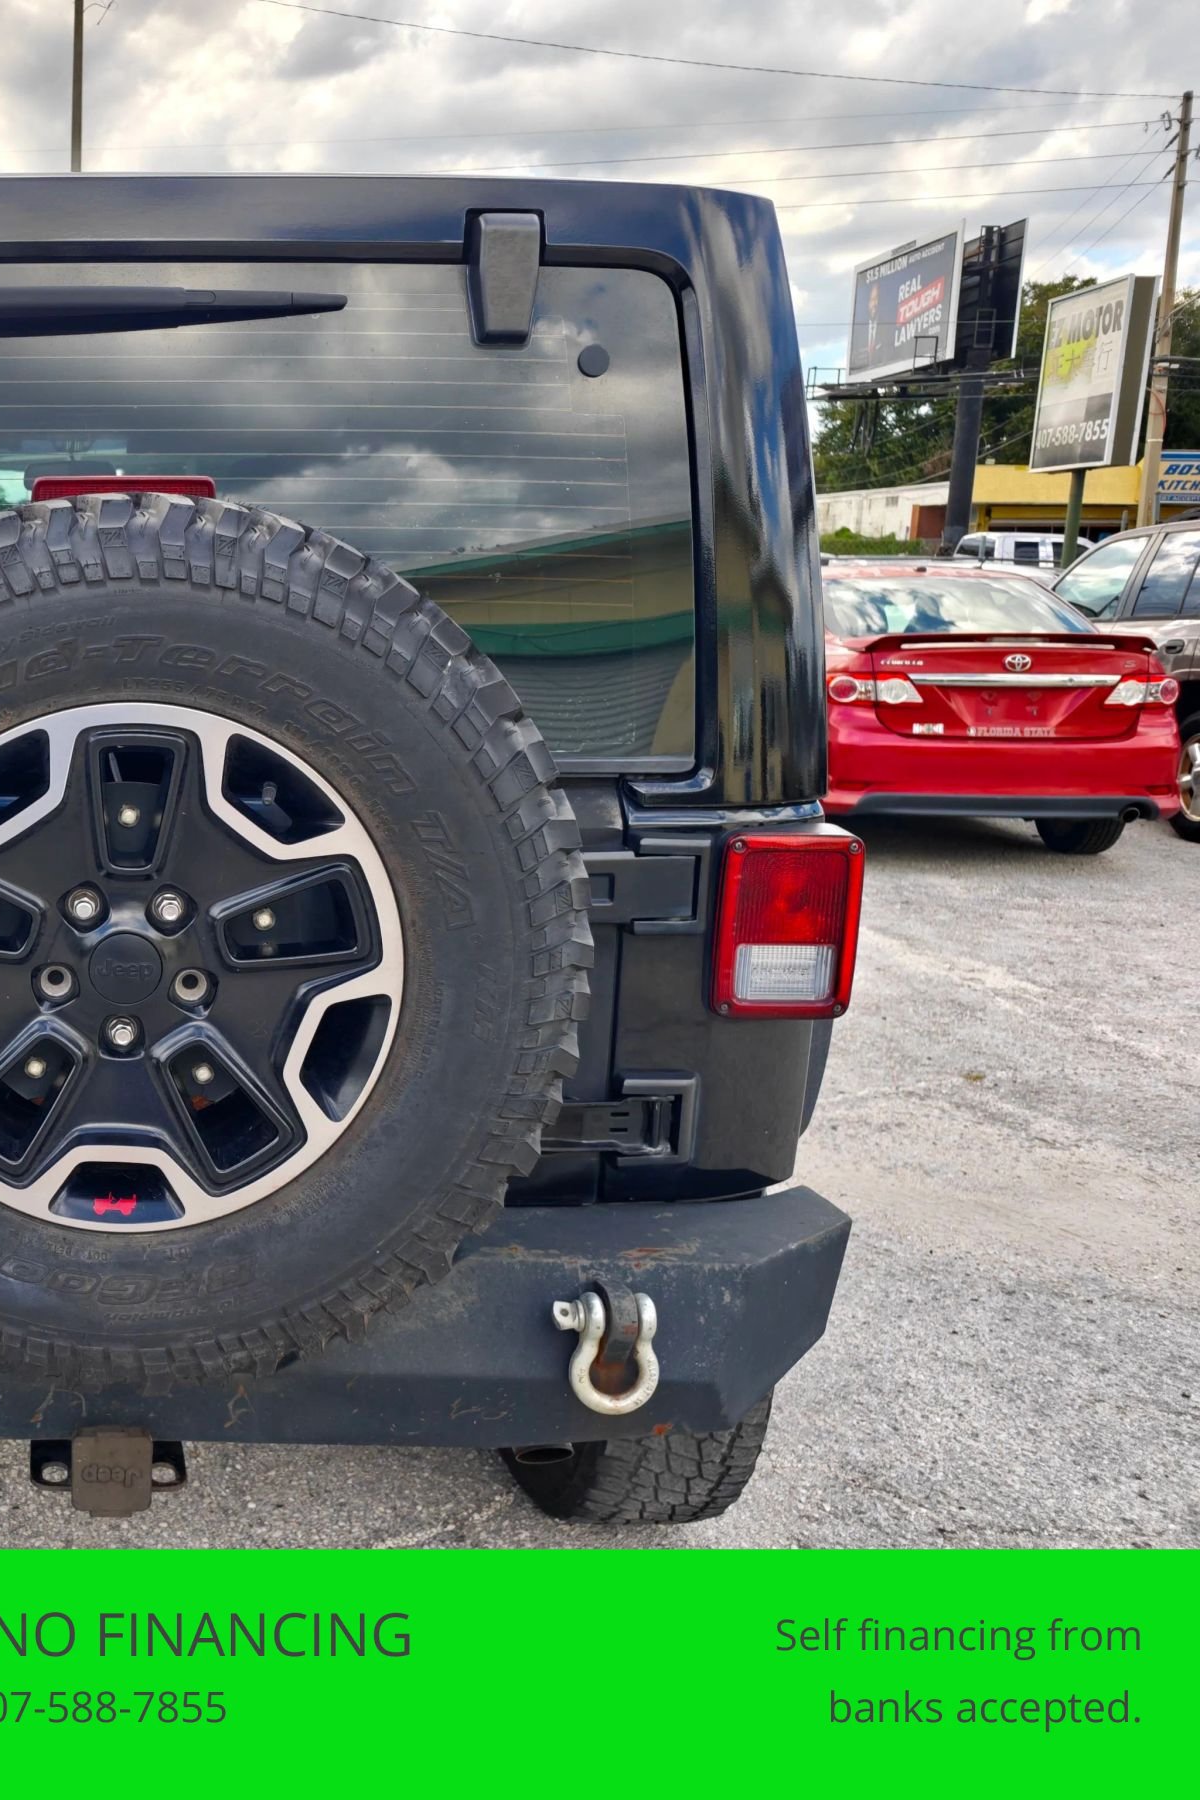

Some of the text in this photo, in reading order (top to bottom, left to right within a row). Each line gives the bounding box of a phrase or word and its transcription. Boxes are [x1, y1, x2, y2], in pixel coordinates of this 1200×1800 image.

[880, 255, 908, 278] MILLION
[898, 274, 922, 303] REAL
[898, 281, 942, 323] TOUGH
[894, 304, 943, 347] LAWYERS
[1067, 300, 1123, 346] MOTOR
[977, 727, 1056, 737] FLORIDA STATE
[96, 959, 154, 979] Jeep
